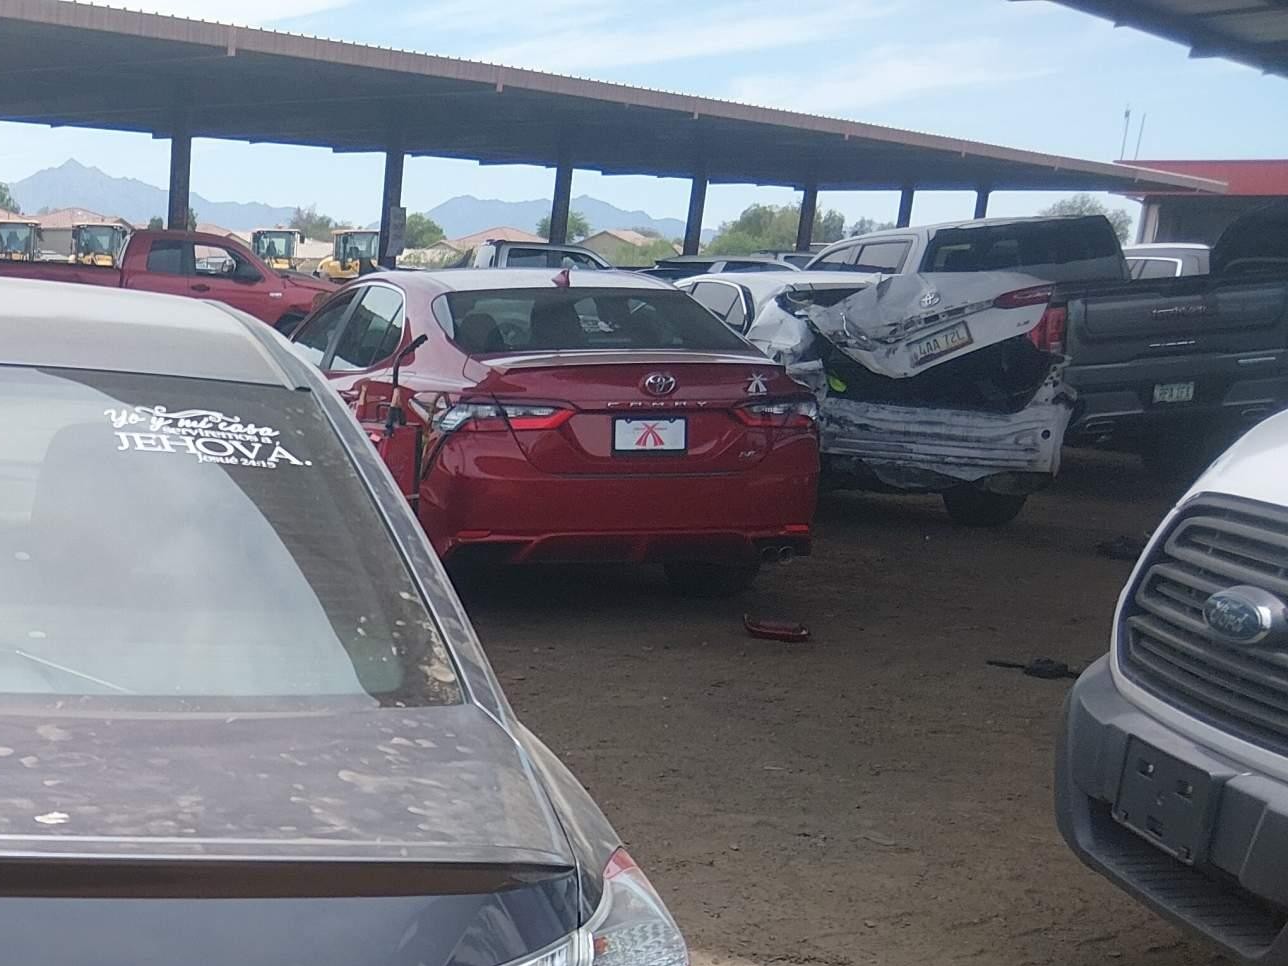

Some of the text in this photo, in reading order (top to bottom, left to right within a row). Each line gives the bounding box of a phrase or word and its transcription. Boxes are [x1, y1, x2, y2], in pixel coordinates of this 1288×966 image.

[104, 408, 145, 428] Yo
[149, 415, 172, 432] y
[217, 420, 281, 438] casa
